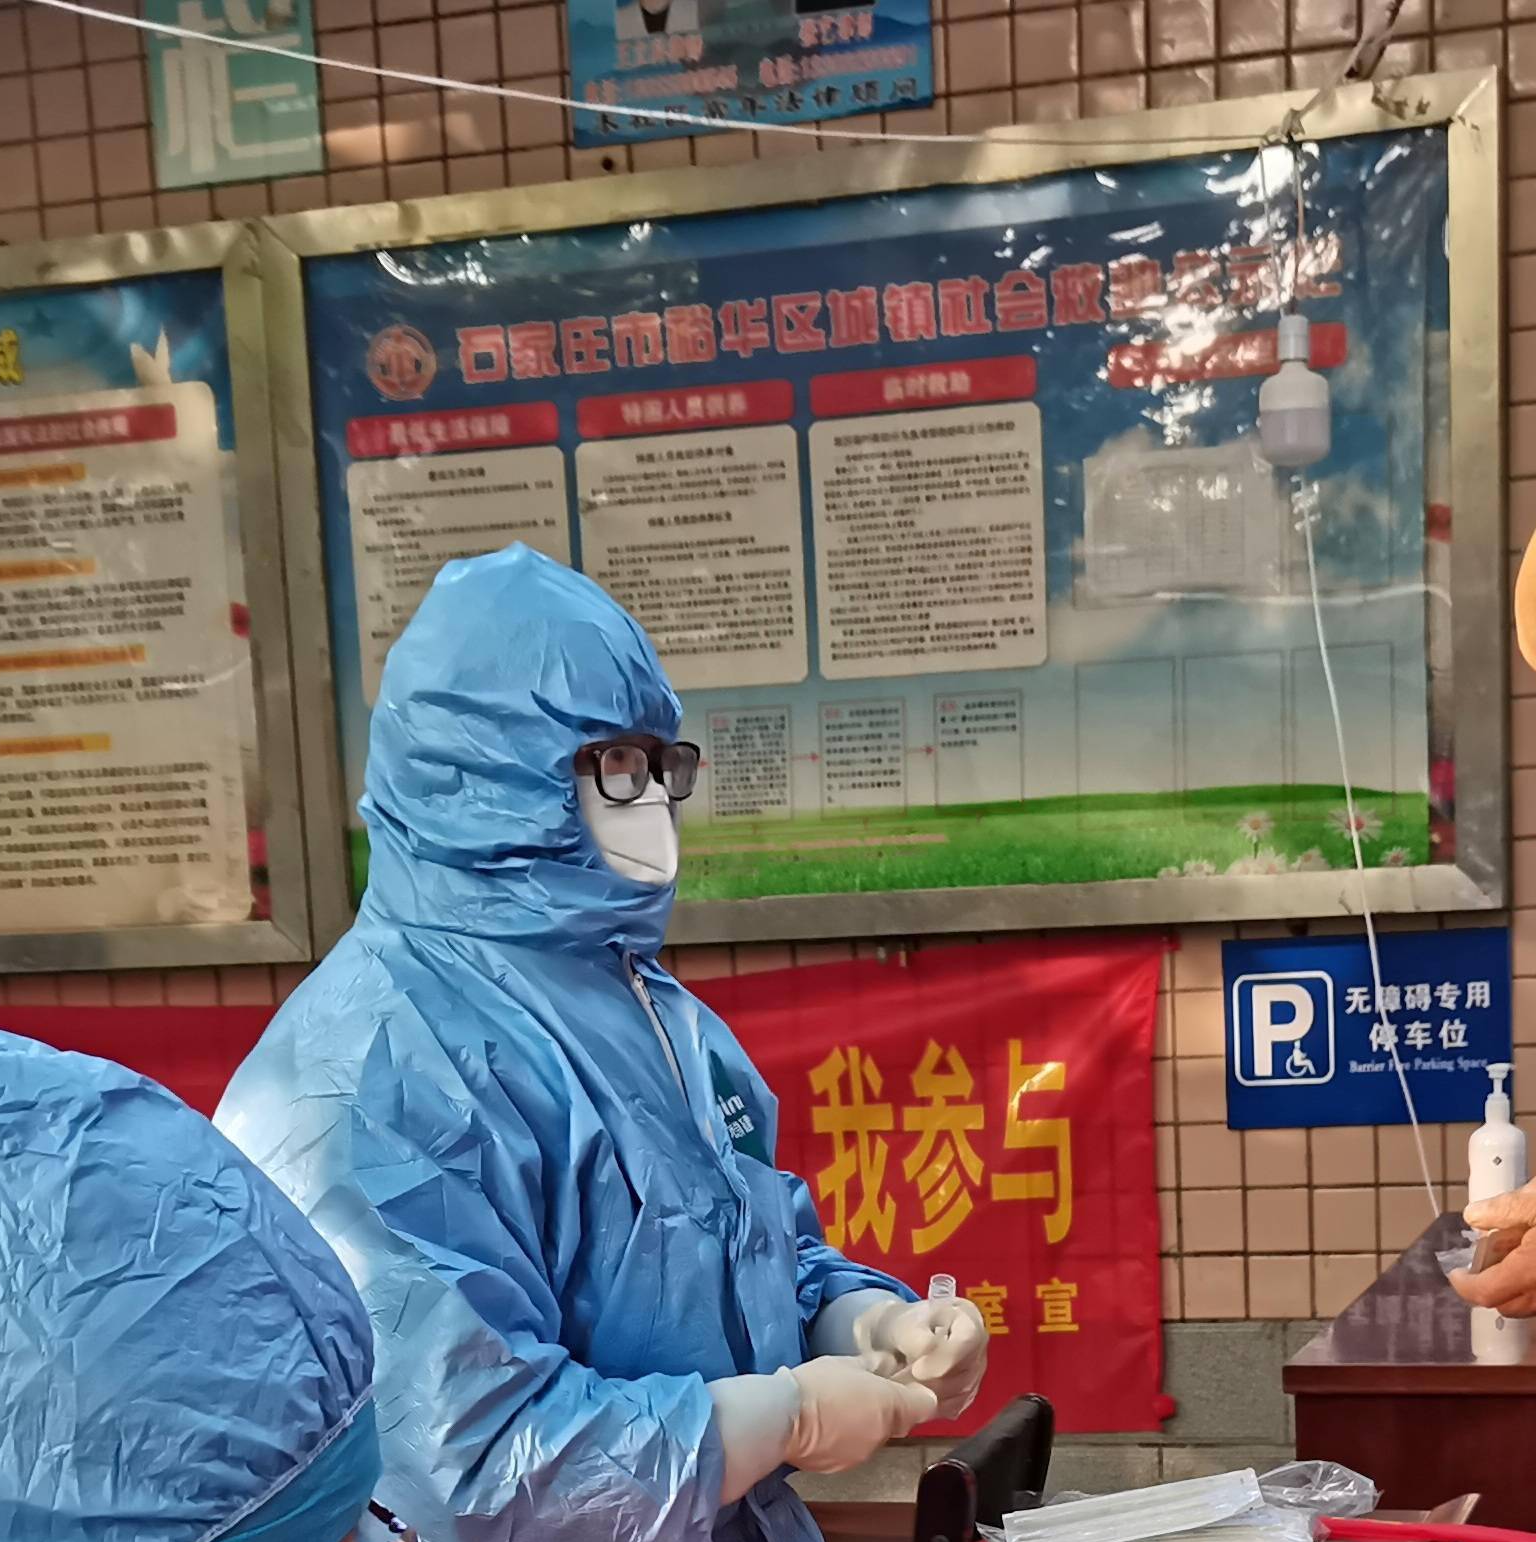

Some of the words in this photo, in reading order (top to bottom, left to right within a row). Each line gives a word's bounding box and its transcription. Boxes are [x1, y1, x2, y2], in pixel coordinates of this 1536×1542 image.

[1345, 980, 1491, 1014] 无障碍专用
[1252, 984, 1314, 1077] P
[1369, 1018, 1468, 1052] 停车位
[1349, 1060, 1385, 1073] Barrier
[1415, 1057, 1455, 1072] Parking
[807, 1037, 1072, 1255] 我参与
